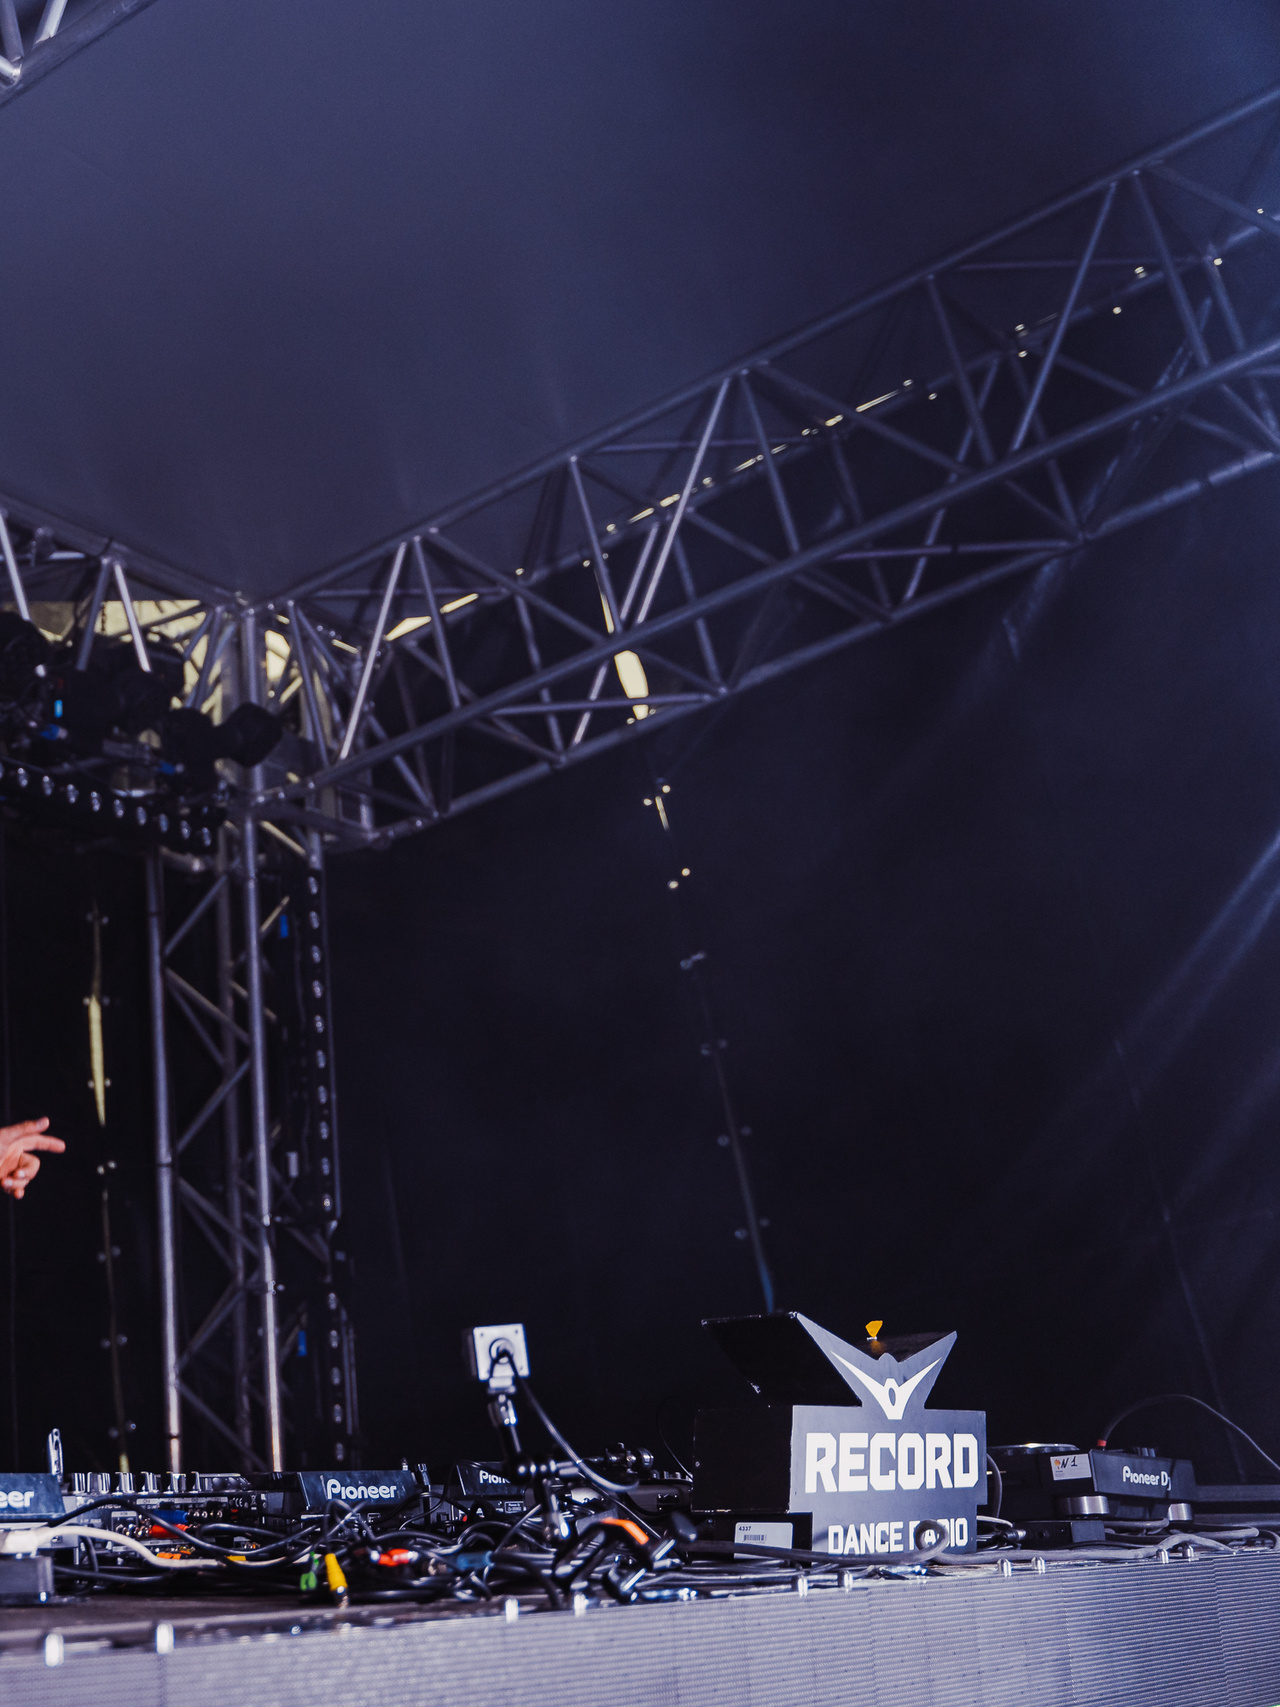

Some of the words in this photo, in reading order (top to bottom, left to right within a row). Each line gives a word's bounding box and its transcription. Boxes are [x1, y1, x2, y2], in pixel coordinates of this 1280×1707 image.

[805, 1432, 979, 1494] RECORD
[1122, 1465, 1160, 1486] Pioneer
[326, 1478, 397, 1500] Pioneer
[828, 1521, 904, 1556] DANCE
